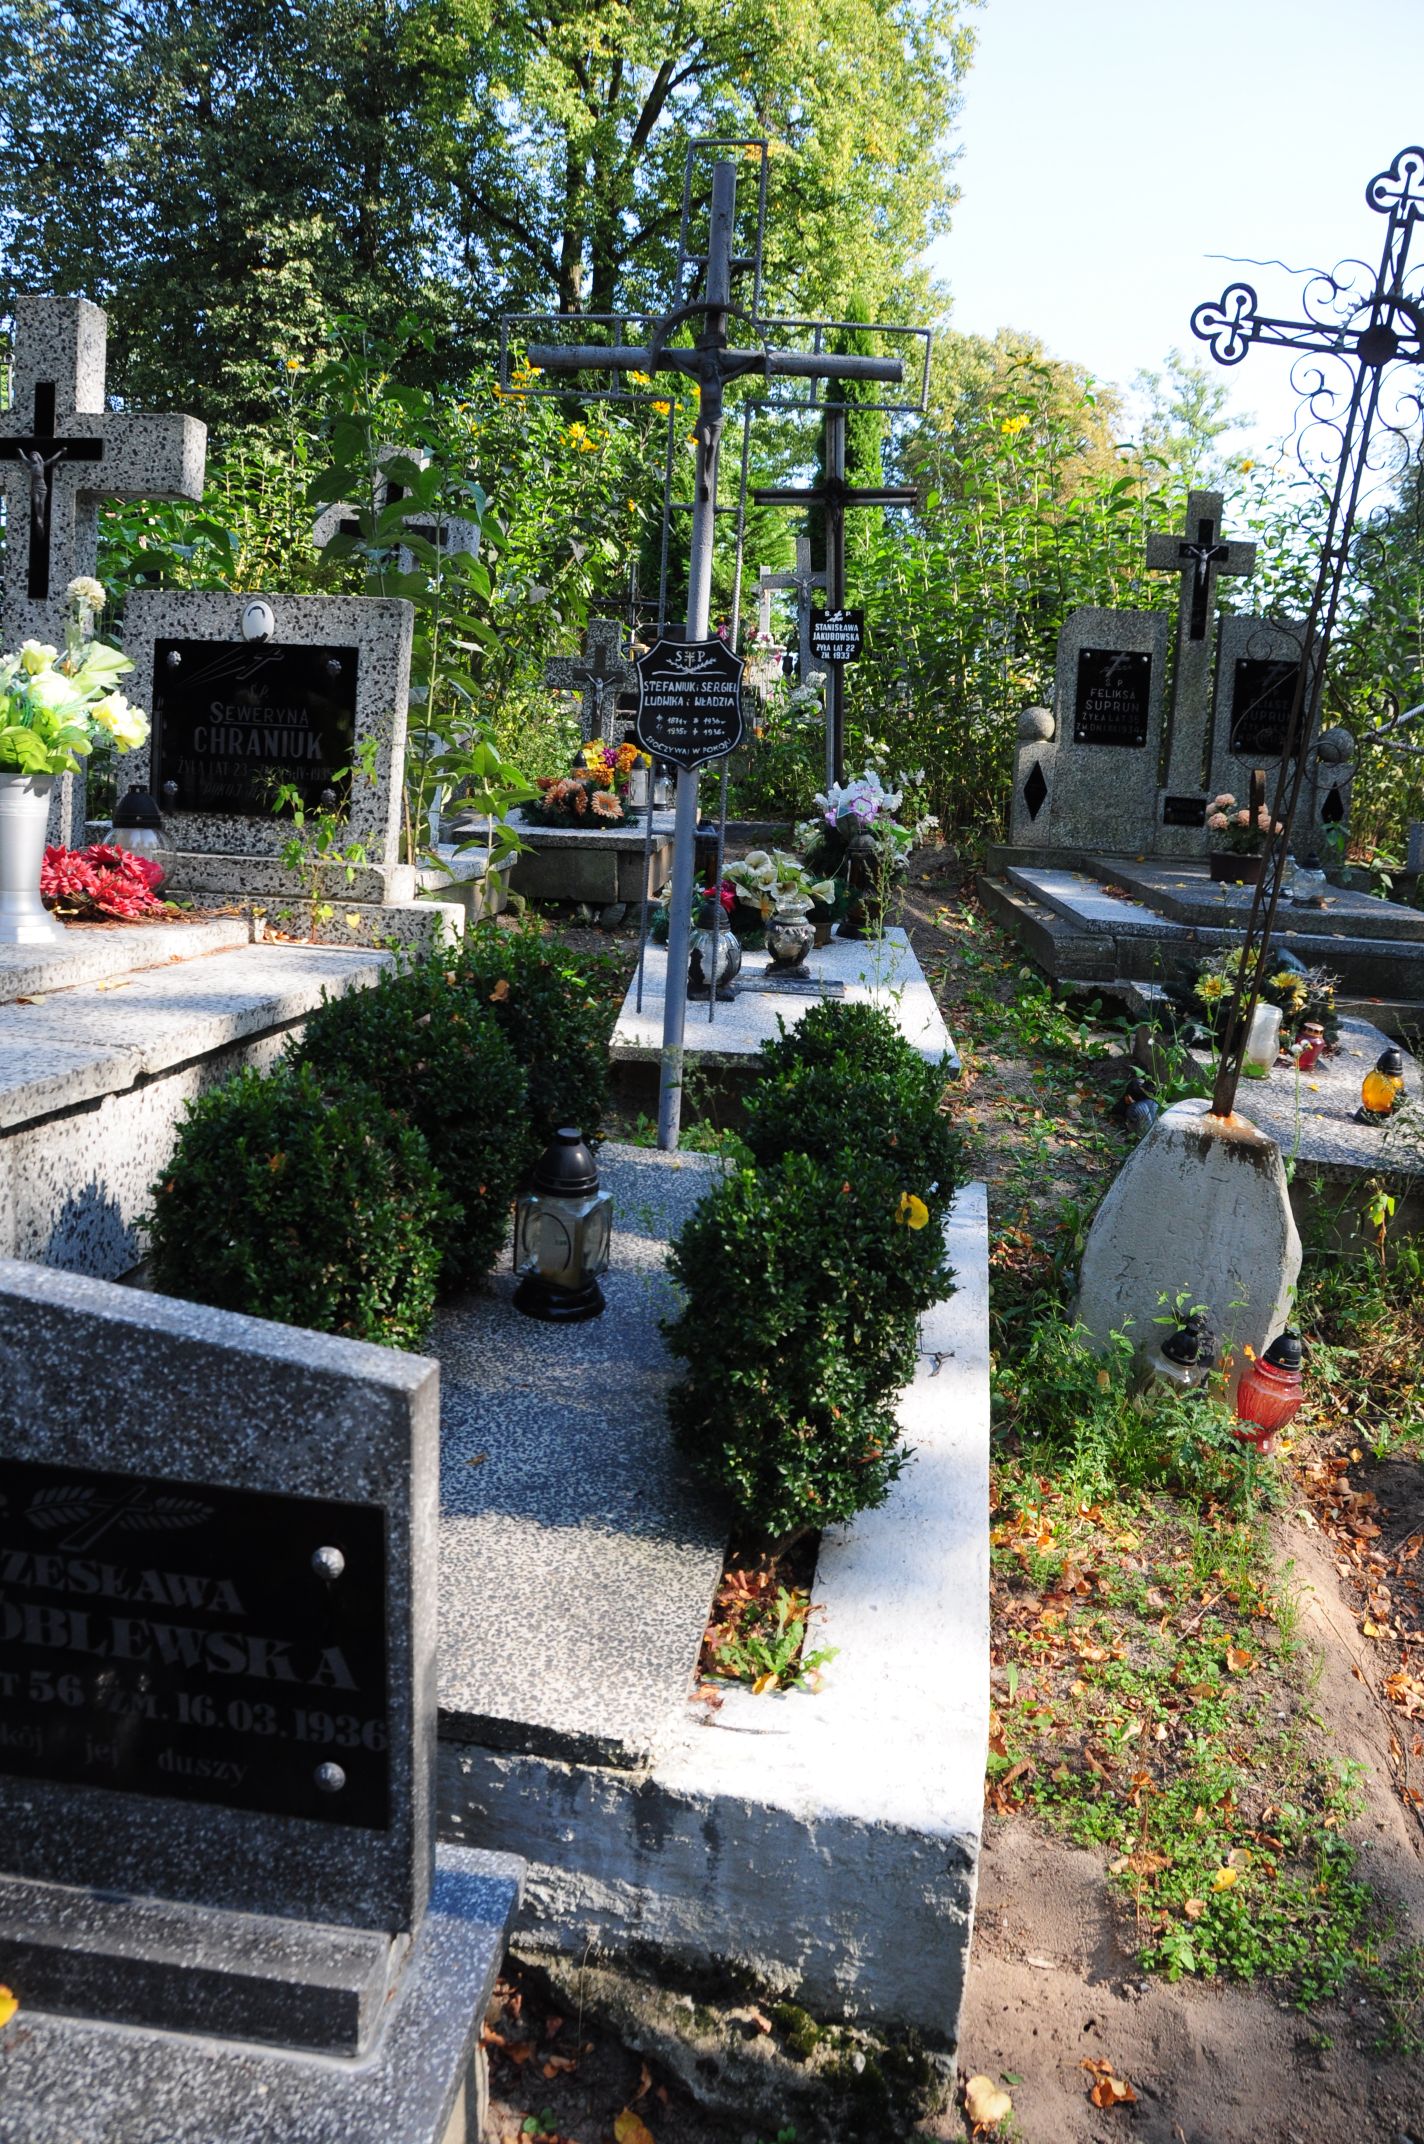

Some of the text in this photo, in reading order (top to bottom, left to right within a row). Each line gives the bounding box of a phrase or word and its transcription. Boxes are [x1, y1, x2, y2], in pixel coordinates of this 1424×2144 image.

[815, 623, 858, 632] STANISŁAWA
[812, 632, 860, 641] JAKUBOWSKA
[833, 644, 843, 652] LAT
[845, 644, 855, 652] 22
[833, 652, 850, 660] 1933
[643, 681, 696, 692] STEFANIUK
[1090, 688, 1136, 700] FELIKSA
[644, 695, 683, 707] LUDWIKA
[694, 696, 735, 707] WŁADZIA
[1085, 699, 1140, 713] SUPRUN
[194, 726, 323, 760] CHRANIUK
[29, 1671, 86, 1707] 56
[158, 1748, 249, 1790] duszy
